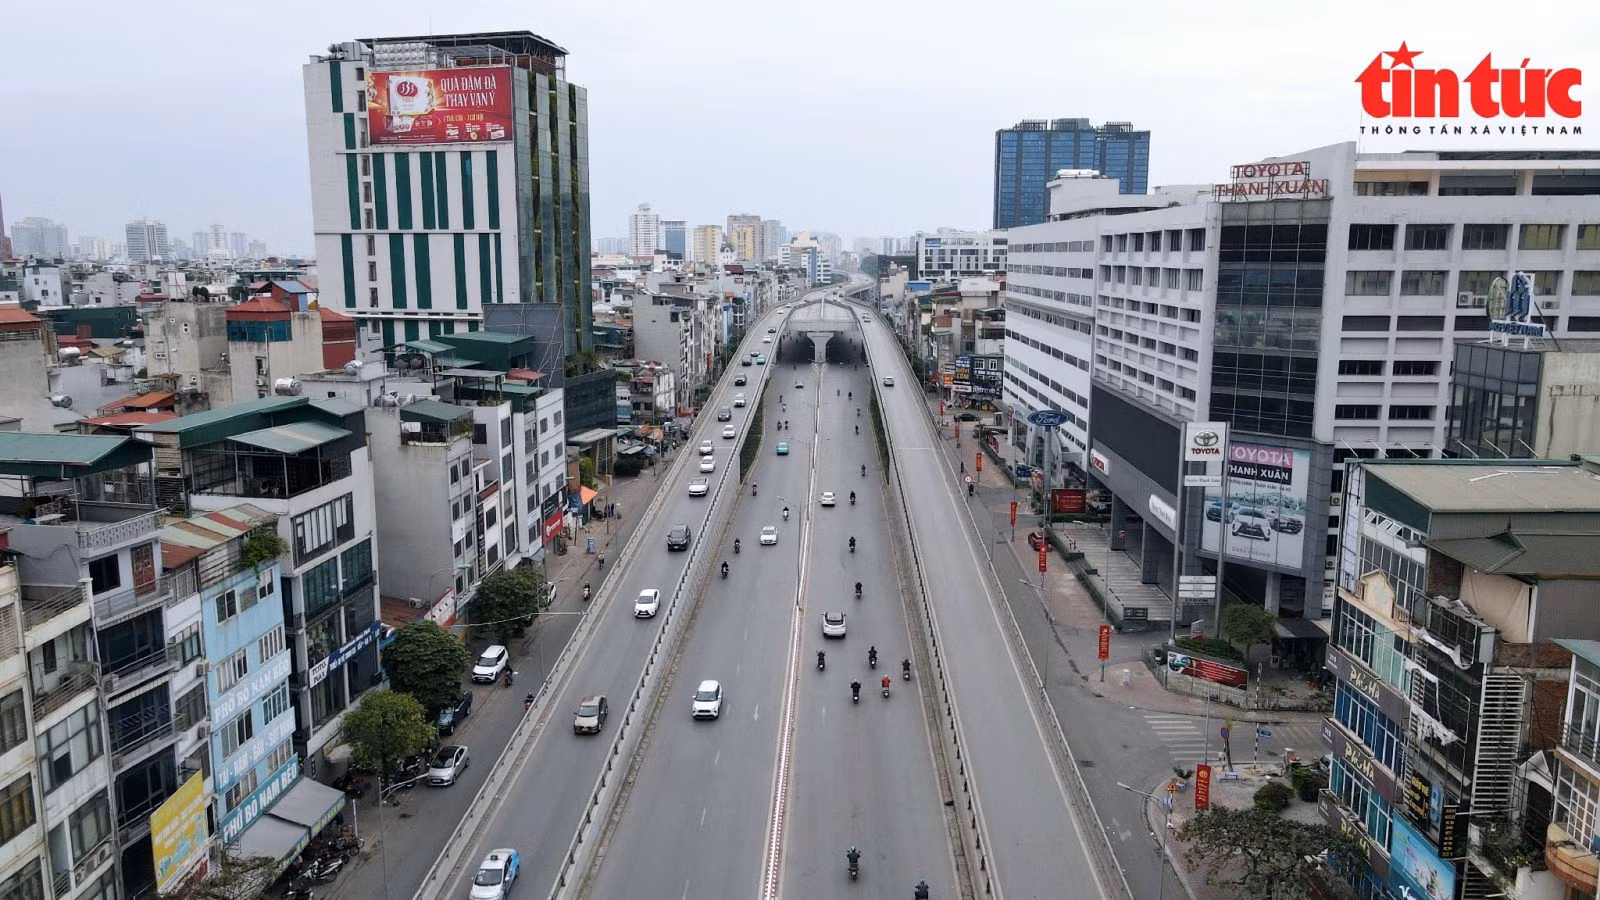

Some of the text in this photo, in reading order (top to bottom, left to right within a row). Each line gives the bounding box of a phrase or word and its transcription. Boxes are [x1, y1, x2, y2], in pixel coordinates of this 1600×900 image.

[444, 93, 469, 107] THAY
[1233, 162, 1305, 178] TOYOTA
[1215, 182, 1271, 197] THANH
[1035, 413, 1061, 424] Ford
[1228, 464, 1290, 480] THANH XUÂN
[252, 672, 272, 696] NAM
[245, 795, 258, 823] BÒ
[259, 778, 280, 810] NAM
[281, 762, 297, 790] BÉO
